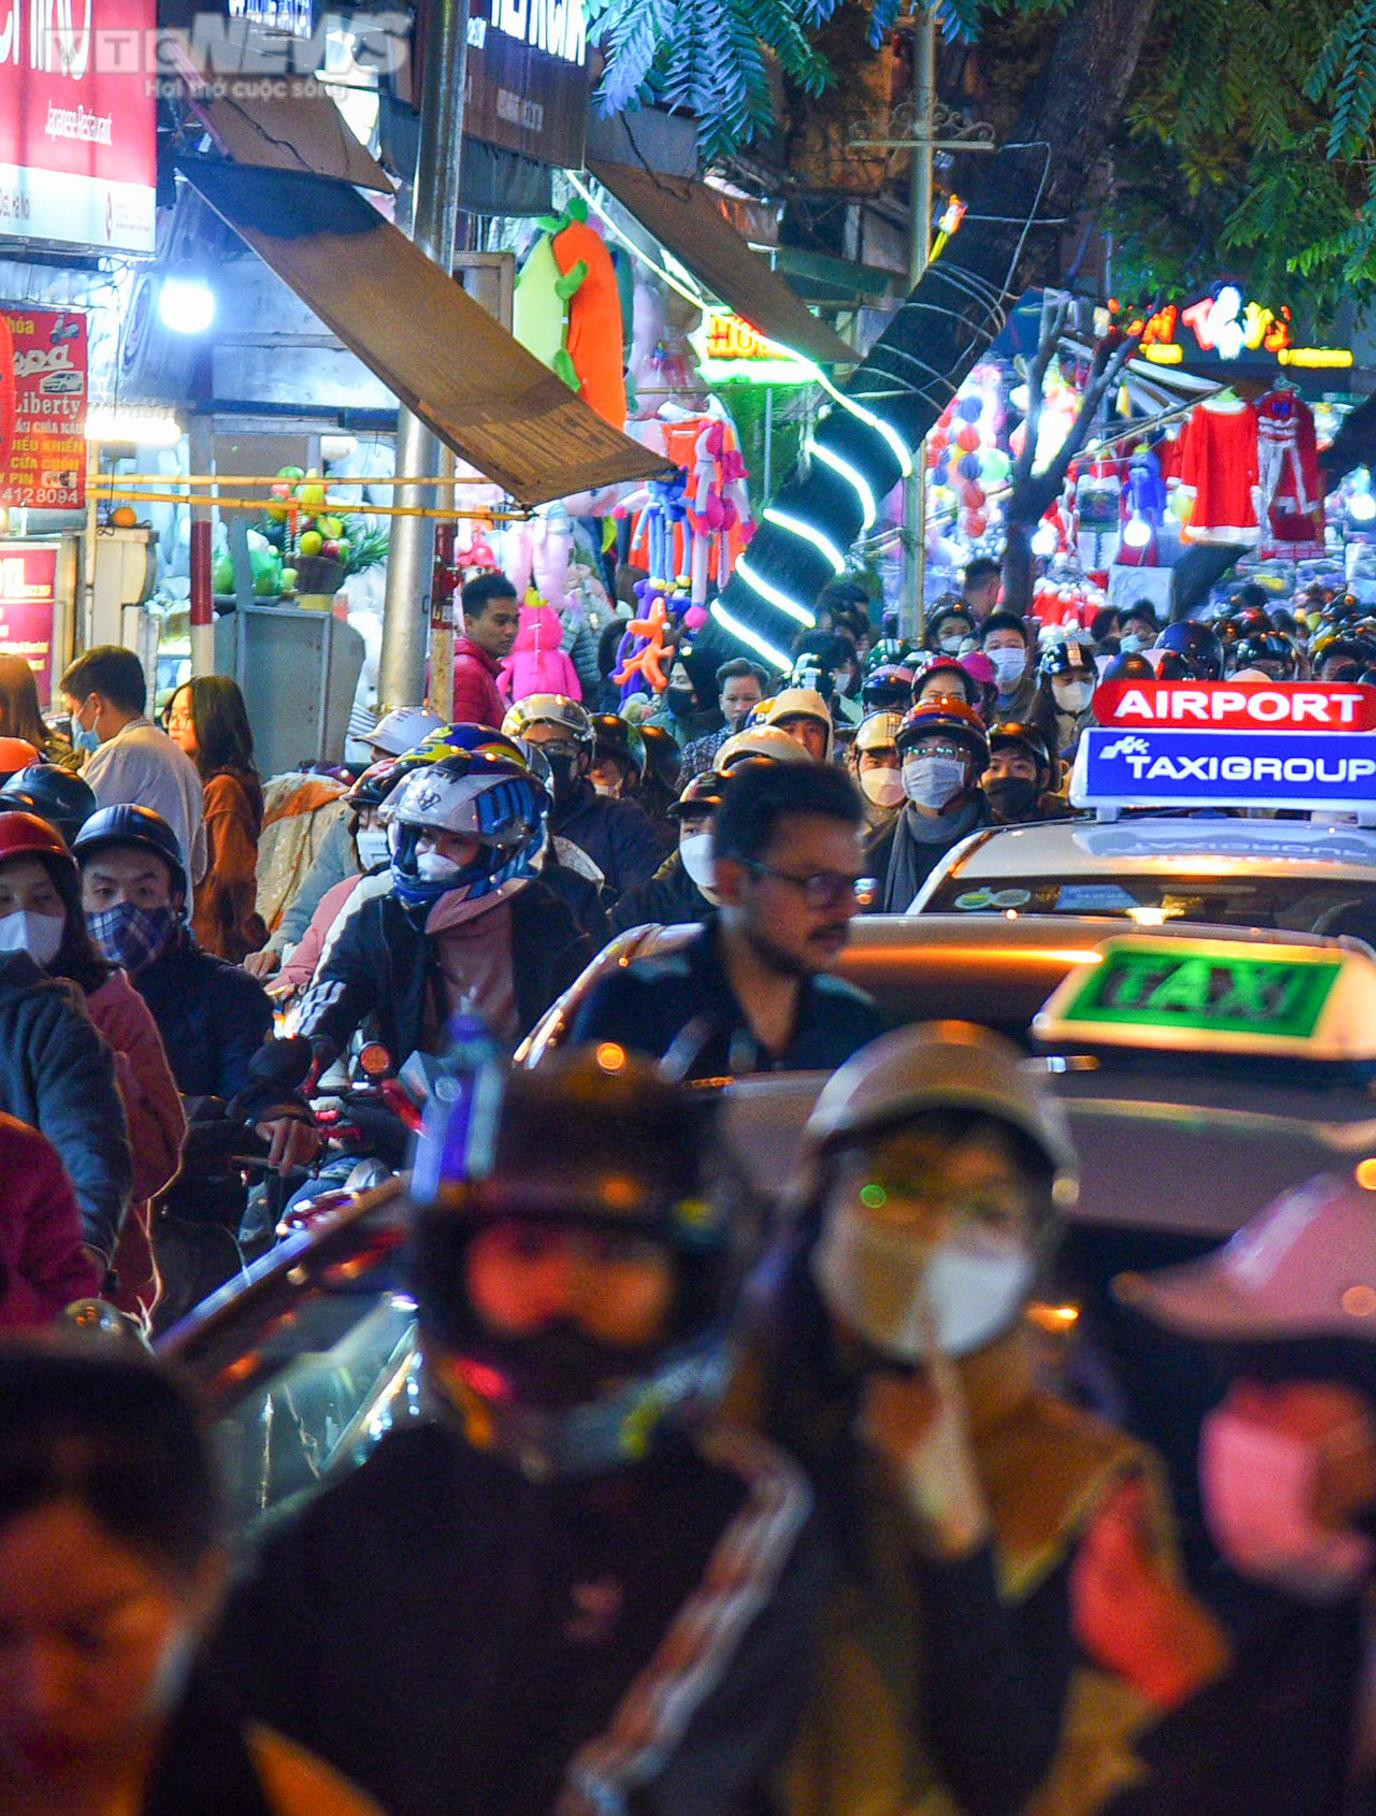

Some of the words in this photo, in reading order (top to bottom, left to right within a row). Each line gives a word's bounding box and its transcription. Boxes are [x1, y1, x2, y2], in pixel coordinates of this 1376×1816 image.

[5, 316, 35, 336] hóa
[1113, 690, 1365, 723] AIRPORT
[1101, 960, 1296, 1020] TAXI
